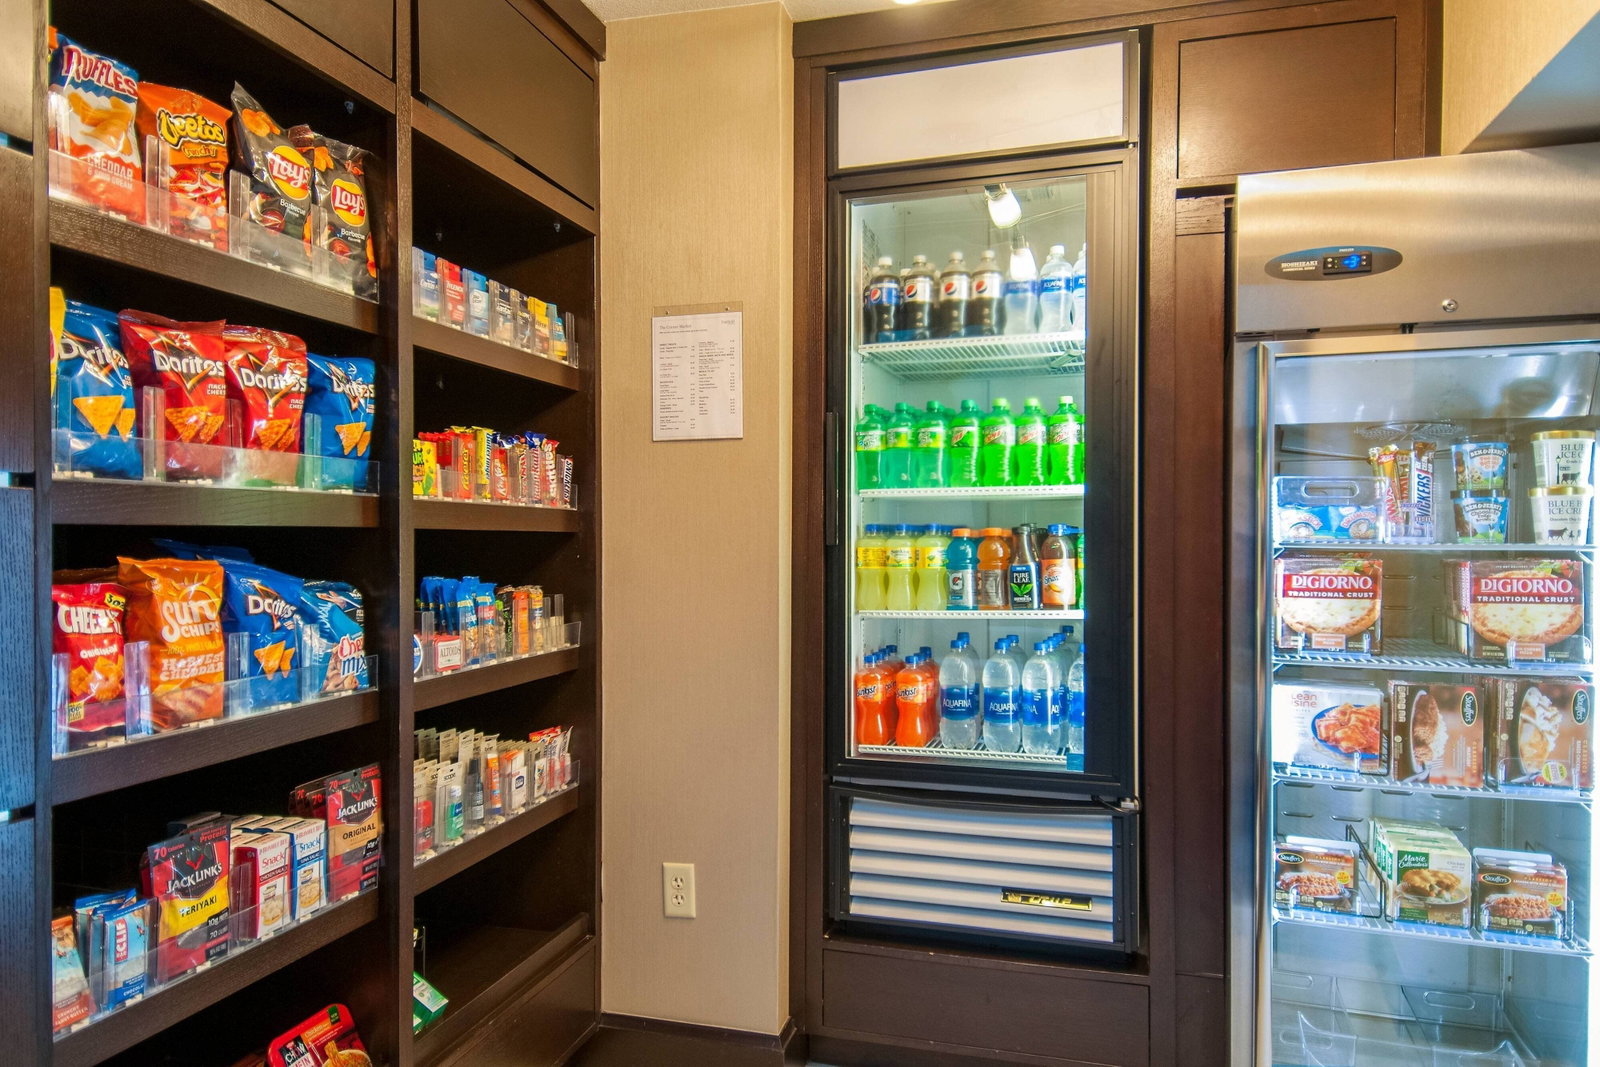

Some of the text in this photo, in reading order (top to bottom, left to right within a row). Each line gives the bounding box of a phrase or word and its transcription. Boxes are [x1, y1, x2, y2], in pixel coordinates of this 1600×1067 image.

[62, 45, 139, 99] RUFFLES
[272, 153, 310, 188] Lay's
[334, 186, 365, 215] Lay's
[153, 349, 225, 377] Doritos
[240, 367, 307, 392] Doritos
[1548, 500, 1574, 508] BLUE
[247, 595, 297, 618] Doritos
[161, 600, 217, 643] Sun
[180, 621, 220, 638] CHIPS
[339, 634, 364, 659] Che
[440, 647, 461, 658] ALTOIDS
[160, 662, 224, 681] CHEDDAR
[943, 698, 972, 709] AQUAFINA
[989, 702, 1019, 712] AQUAFINA
[1464, 694, 1475, 722] Stouffer's
[1576, 692, 1587, 721] Stouffer's
[336, 804, 358, 820] JACK
[200, 829, 227, 842] Protein
[342, 823, 377, 840] ORIGINAL
[153, 846, 168, 860] 70
[300, 837, 320, 852] Snack
[262, 852, 285, 867] Snack
[1401, 854, 1426, 862] Marie
[167, 873, 196, 894] JACK
[180, 895, 217, 918] TERIYAKI
[116, 923, 127, 953] CLIF
